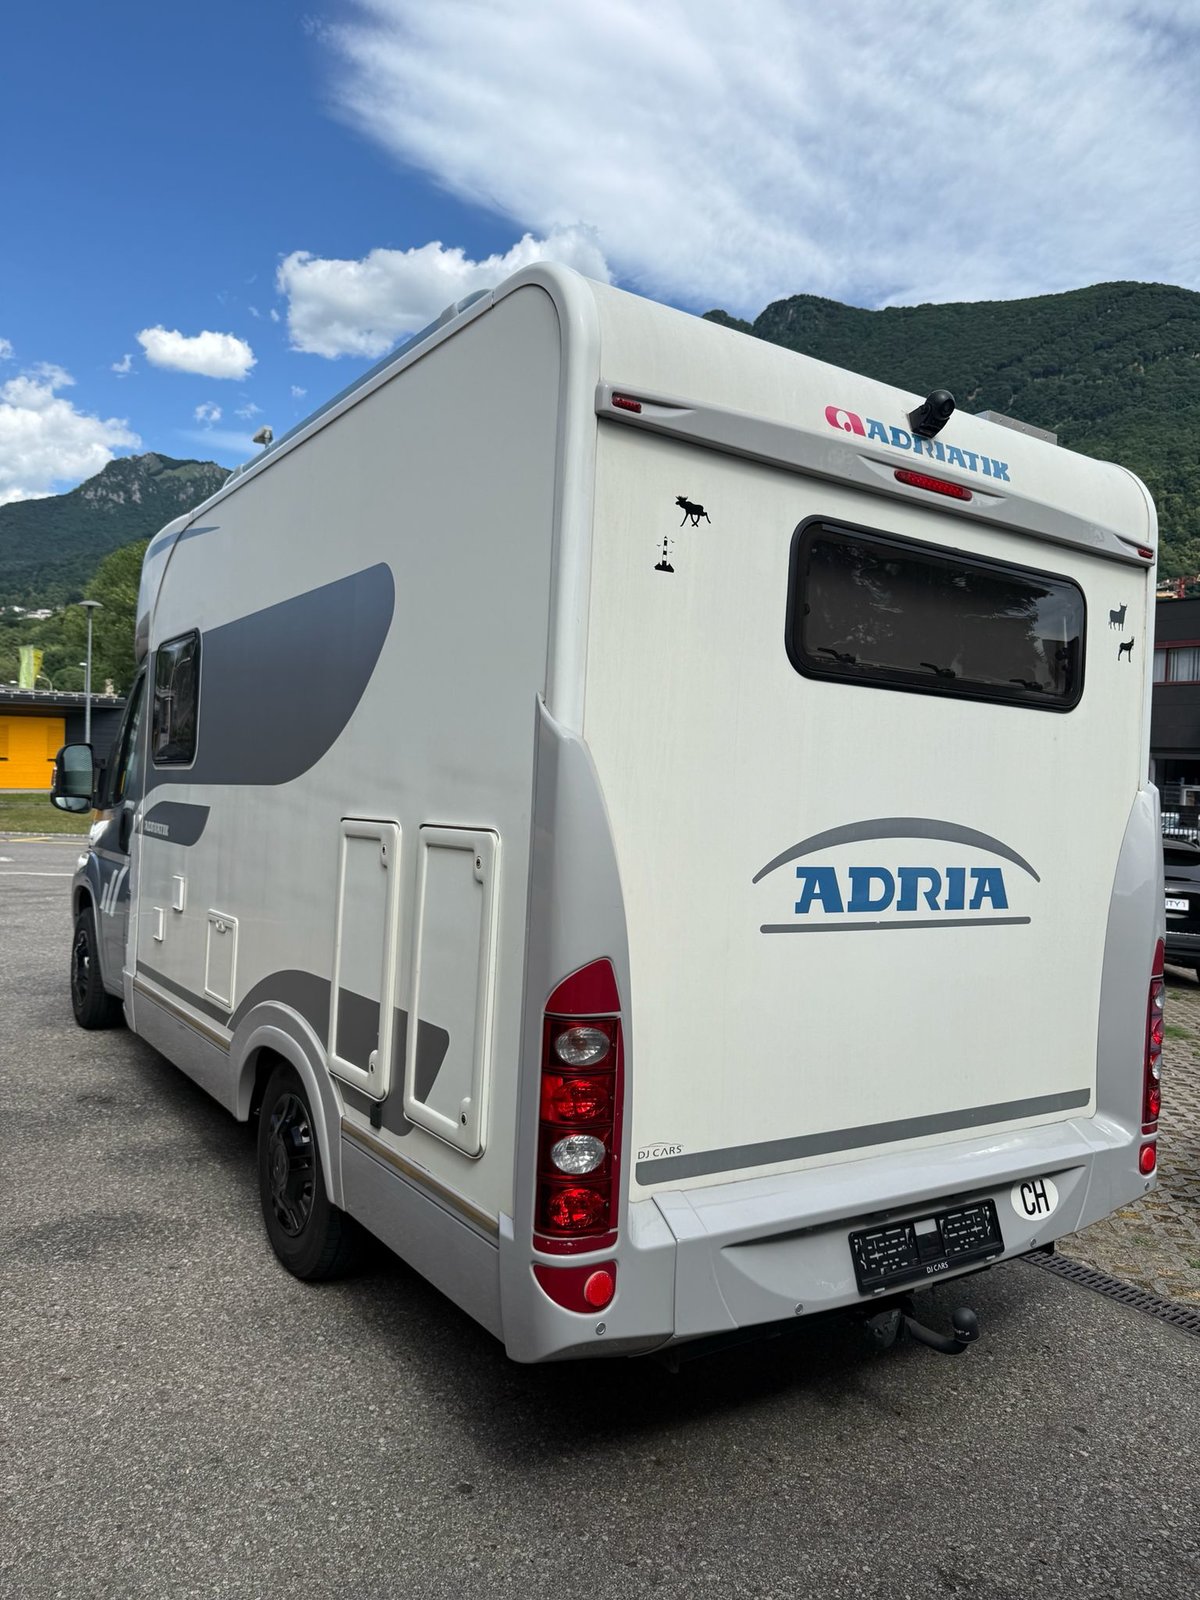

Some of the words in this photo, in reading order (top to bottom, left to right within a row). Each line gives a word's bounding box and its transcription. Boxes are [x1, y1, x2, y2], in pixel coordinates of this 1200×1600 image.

[866, 418, 1010, 482] ADRIATIK
[795, 866, 1009, 914] ADRIA
[638, 1150, 650, 1160] DJ
[652, 1145, 682, 1157] CARS
[1020, 1179, 1050, 1216] CH
[934, 1262, 949, 1272] CARS
